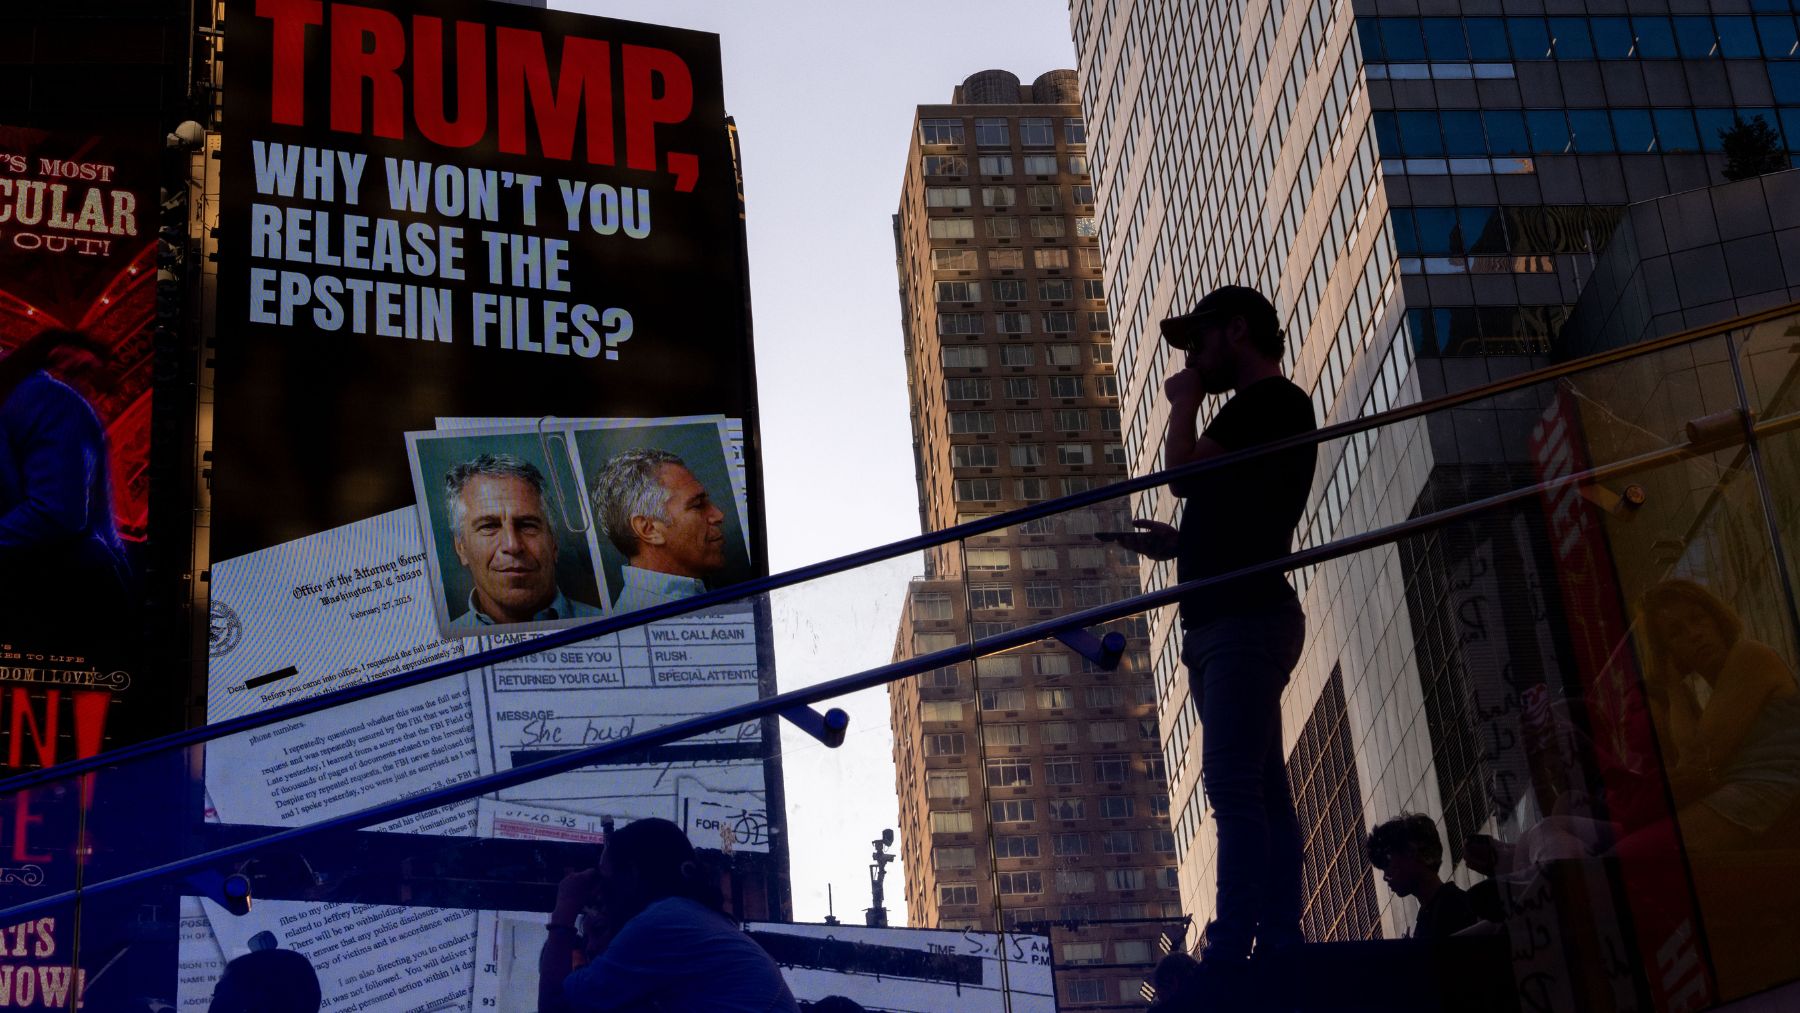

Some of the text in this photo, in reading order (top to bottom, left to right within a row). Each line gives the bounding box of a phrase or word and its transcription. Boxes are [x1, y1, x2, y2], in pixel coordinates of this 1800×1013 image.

[255, 0, 700, 193] TRUMP,
[0, 154, 115, 182] 'S MOST
[252, 140, 652, 239] WHY WON'T YOU
[13, 232, 112, 257] OUT!
[250, 203, 571, 293] RELEASE THE
[249, 267, 634, 361] EPSTEIN FILES?
[293, 584, 323, 599] Office
[325, 577, 336, 589] of
[337, 573, 353, 586] the
[354, 561, 398, 580] Attorney
[349, 605, 381, 620] February
[652, 629, 745, 641] WILL CALL AGAIN
[261, 690, 287, 703] Before
[287, 686, 302, 697] you
[302, 679, 322, 690] came
[322, 673, 337, 684] into
[366, 652, 400, 670] requested
[400, 649, 412, 658] the
[413, 644, 425, 654] full
[426, 640, 440, 650] and
[560, 652, 583, 663] SEE
[585, 651, 612, 662] YOU
[655, 651, 687, 661] RUSH
[51, 670, 95, 685] LOVE
[227, 683, 246, 695] Dear
[499, 673, 620, 686] RETURNED YOUR CALL
[658, 671, 706, 682] SPECIAL
[288, 694, 450, 754] repeatedly questioned whether this was the full
[496, 710, 554, 721] MESSAGE
[249, 732, 272, 746] phone
[262, 761, 289, 775] request
[290, 756, 303, 765] and
[304, 751, 320, 760] was
[320, 739, 357, 756] repeatedly
[396, 721, 408, 730] the
[408, 716, 423, 726] FBI
[423, 711, 437, 721] that
[327, 751, 353, 766] learned
[354, 747, 373, 757] from
[403, 731, 417, 741] that
[418, 727, 430, 736] the
[430, 720, 445, 731] FBI
[444, 714, 463, 727] Field
[275, 740, 464, 809] Despite my repeated the FBI never disclosed
[280, 776, 317, 794] thousands
[327, 767, 349, 780] pages
[358, 750, 397, 768] documents
[398, 740, 422, 754] related
[281, 810, 295, 820] and
[301, 800, 322, 813] spoke
[360, 784, 375, 794] you
[375, 776, 394, 786] were
[695, 819, 720, 830] FOR
[280, 906, 321, 926] files my
[285, 910, 351, 939] related Jeffrey
[289, 938, 314, 951] There
[314, 930, 332, 941] will
[331, 928, 343, 936] be
[313, 943, 340, 957] ensure
[340, 936, 357, 947] that
[357, 932, 372, 943] any
[373, 920, 398, 937] public
[342, 945, 373, 960] victims
[373, 938, 389, 950] and
[398, 920, 443, 940] accordance
[443, 912, 462, 923] with
[332, 993, 349, 1004] was
[349, 987, 365, 997] not
[405, 965, 422, 976] You
[422, 958, 440, 970] will
[440, 949, 468, 964] deliver
[344, 933, 470, 985] am also directing you conduct
[358, 988, 397, 1011] personnel
[398, 979, 423, 994] action
[424, 969, 450, 984] within
